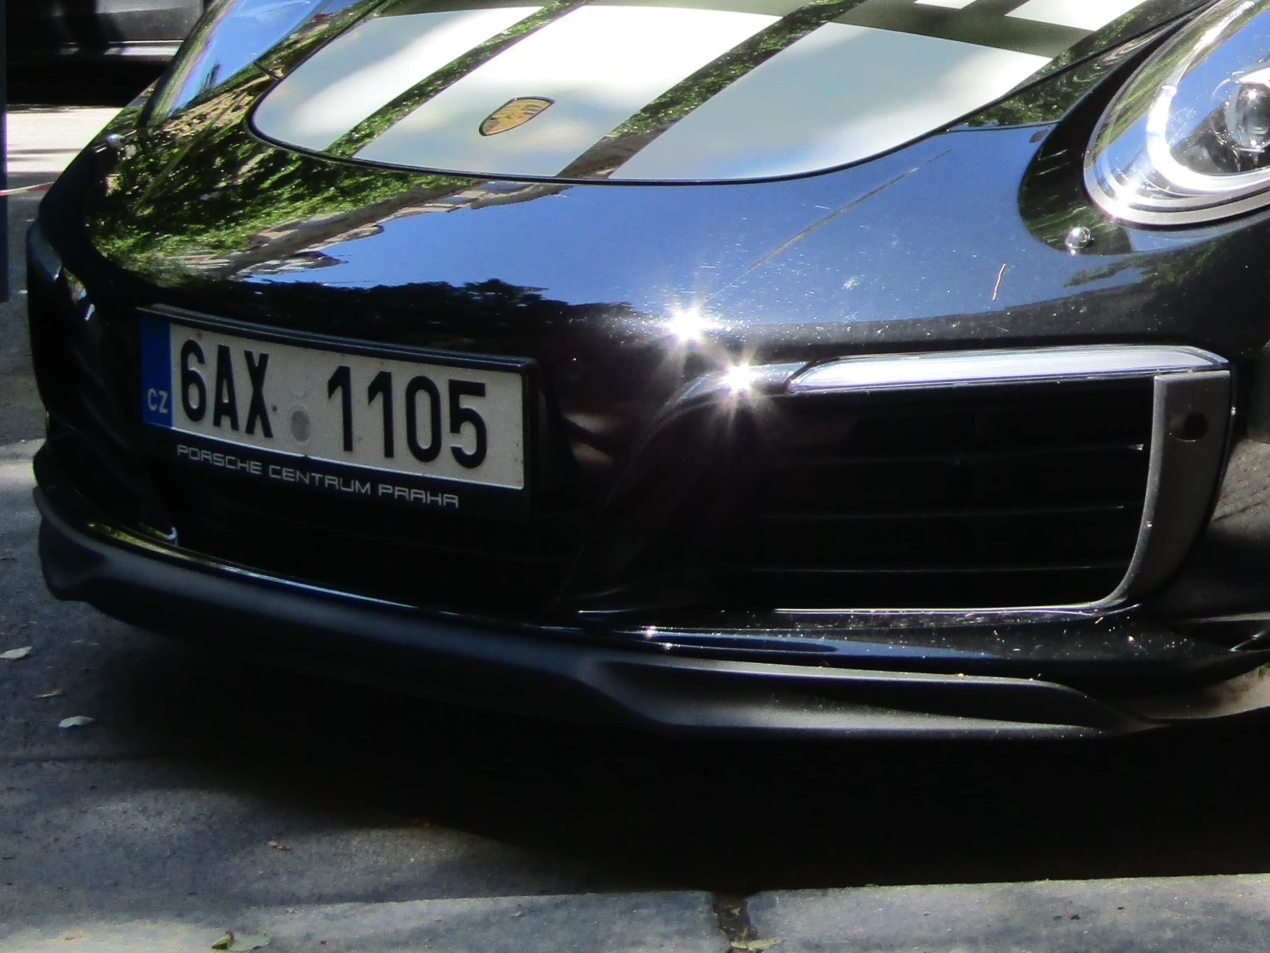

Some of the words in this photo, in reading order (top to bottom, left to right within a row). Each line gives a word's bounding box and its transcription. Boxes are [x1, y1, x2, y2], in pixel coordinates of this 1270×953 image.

[147, 386, 169, 415] CZ
[180, 339, 274, 439] 6AX
[327, 365, 488, 470] 1105
[176, 444, 263, 475] PORSCHE
[268, 464, 371, 495] CENTRUM
[378, 483, 459, 509] PRAHA
